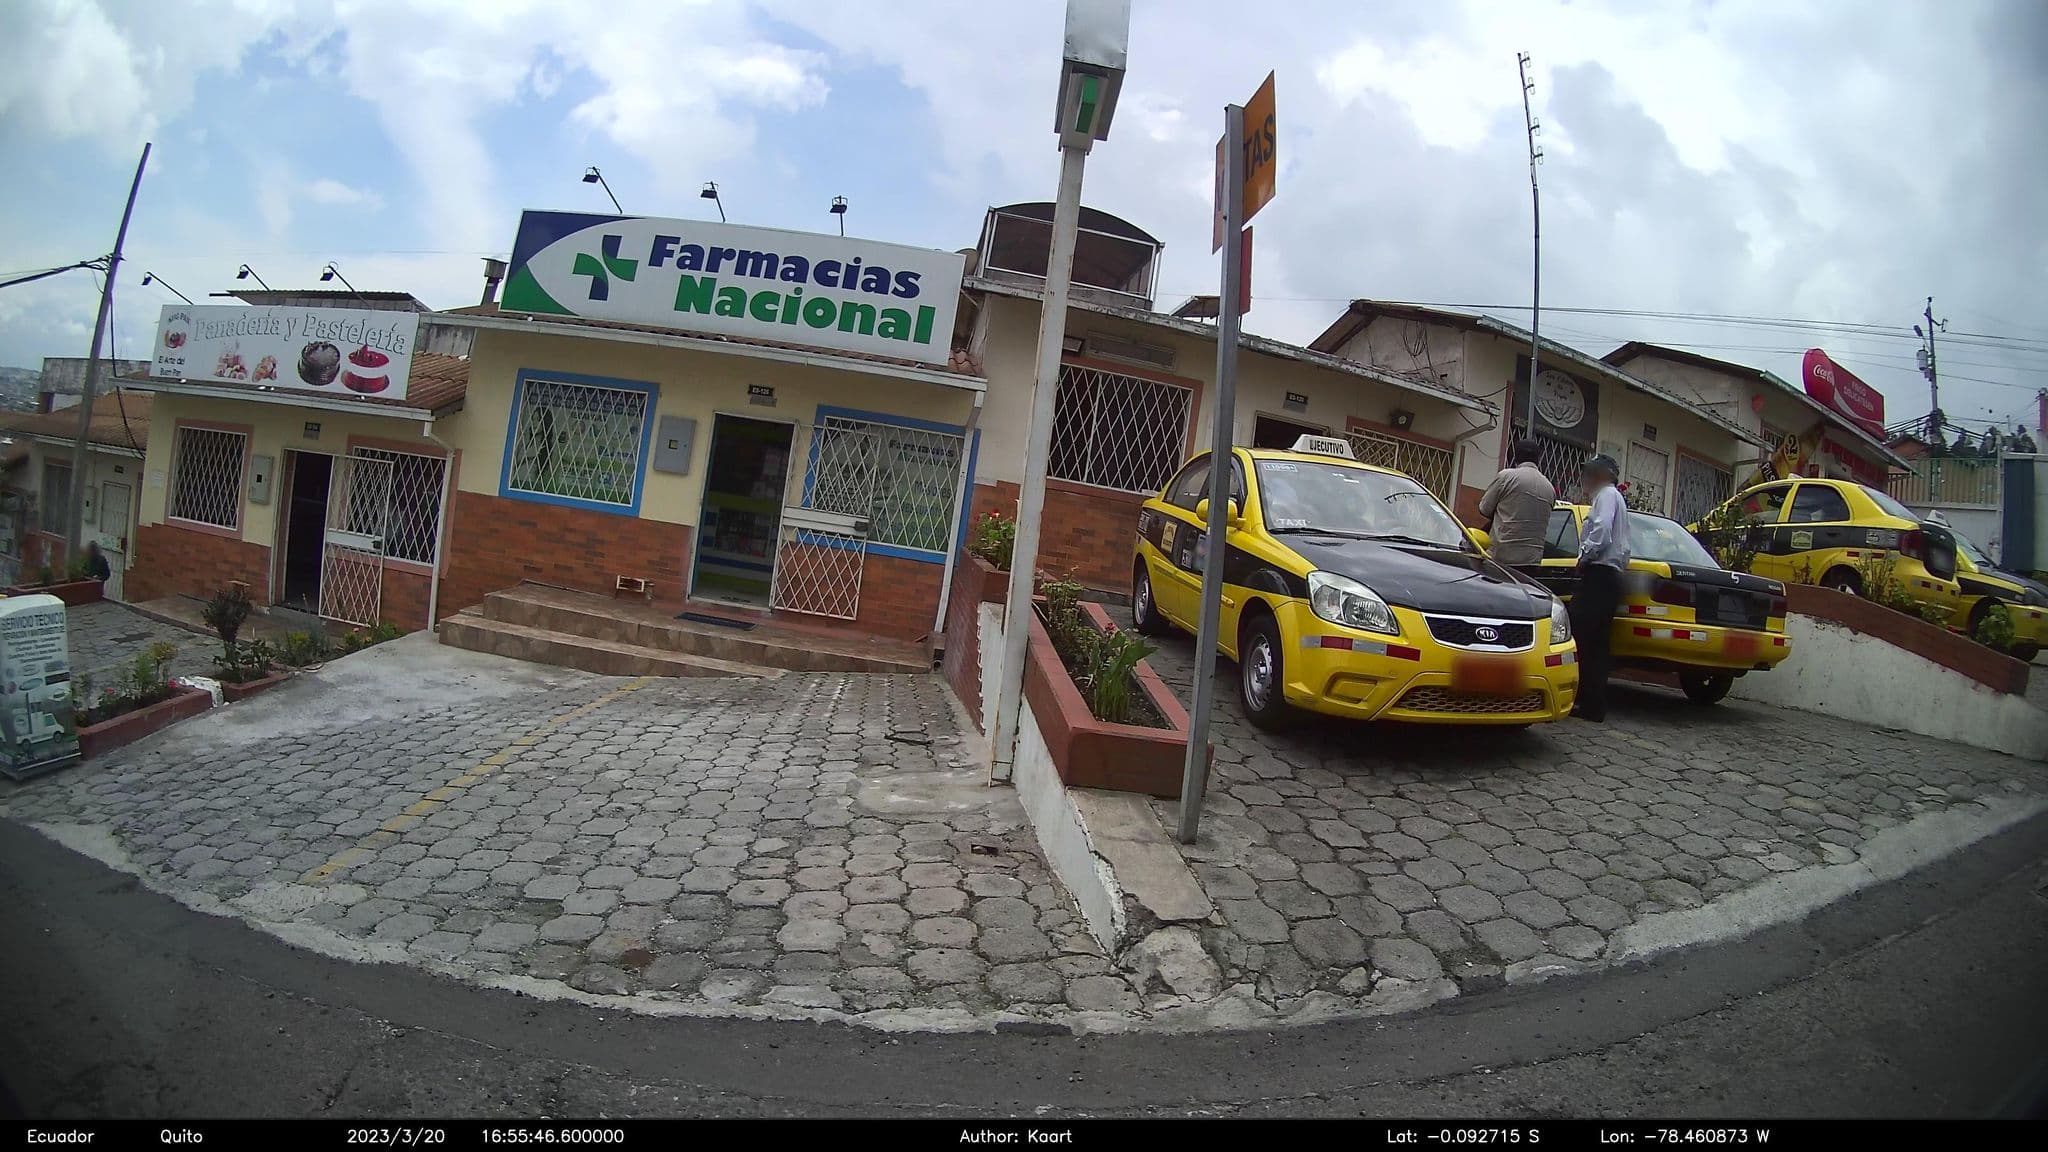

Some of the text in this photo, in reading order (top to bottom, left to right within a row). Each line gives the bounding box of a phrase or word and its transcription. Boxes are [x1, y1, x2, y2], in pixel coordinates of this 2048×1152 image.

[647, 234, 922, 299] Farmacias
[193, 308, 407, 356] Panadería y Pastelería
[673, 274, 937, 345] Nacional
[1730, 571, 1740, 584] 5
[1479, 629, 1495, 638] KIA
